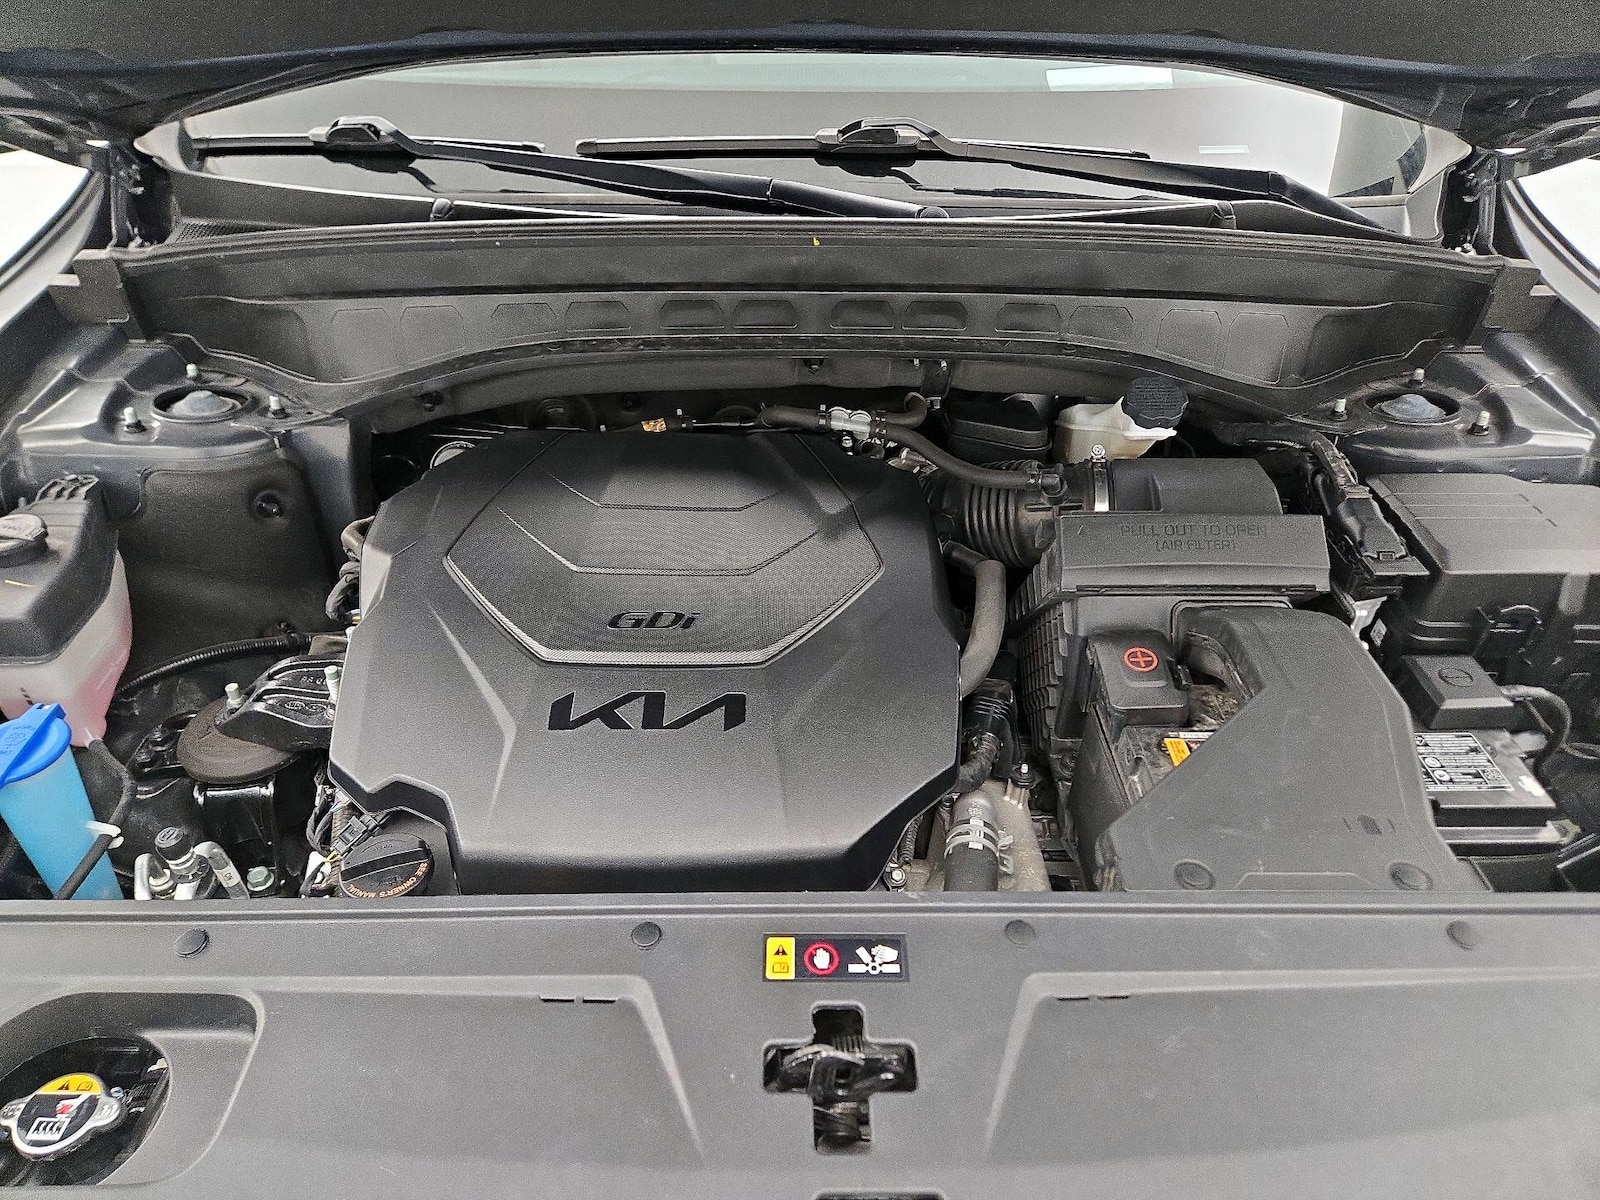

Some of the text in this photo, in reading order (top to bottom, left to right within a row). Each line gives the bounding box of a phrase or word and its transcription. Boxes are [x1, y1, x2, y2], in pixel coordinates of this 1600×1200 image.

[1120, 524, 1267, 536] PULL OUT TO OPEN
[607, 611, 700, 629] GDi
[548, 691, 747, 731] KIA
